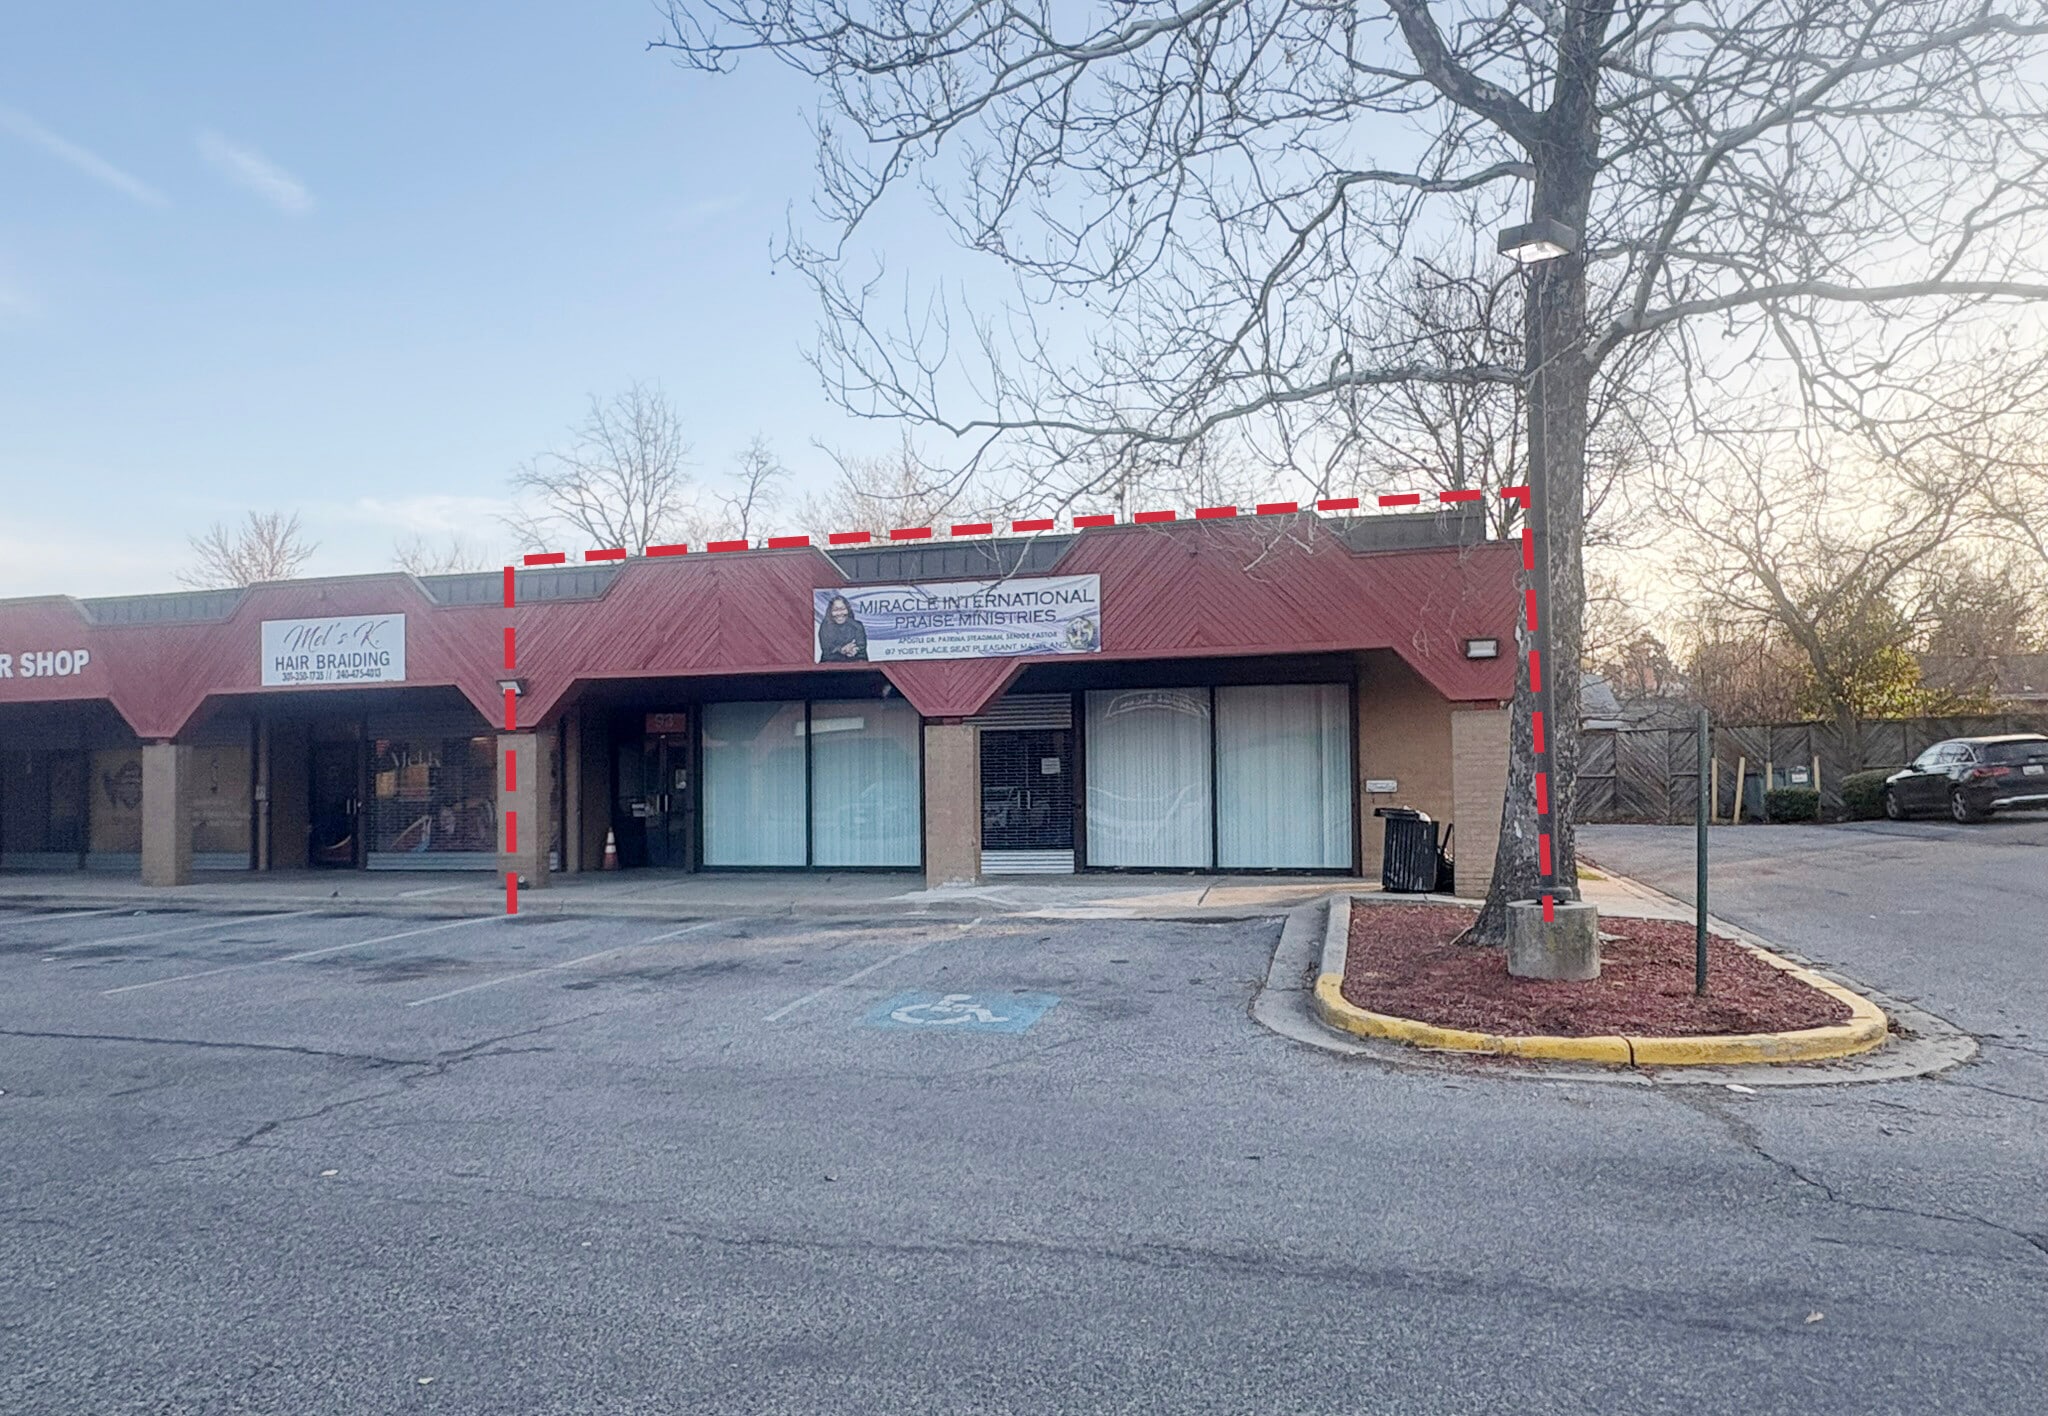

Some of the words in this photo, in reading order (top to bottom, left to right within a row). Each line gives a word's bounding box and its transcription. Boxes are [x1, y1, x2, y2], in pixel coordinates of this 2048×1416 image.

[858, 596, 939, 615] MIRACLE
[943, 589, 1095, 611] INTERNATIONAL
[895, 614, 954, 629] PRAISE
[958, 610, 1057, 628] MINISTRIES
[283, 622, 348, 653] Mel's
[1006, 632, 1031, 640] SENIOR
[1031, 631, 1058, 639] PASTOR
[920, 645, 947, 655] PLACE
[949, 645, 971, 654] SEAT
[20, 650, 90, 678] SHOP
[275, 655, 310, 672] HAIR
[316, 651, 390, 670] BRAIDING
